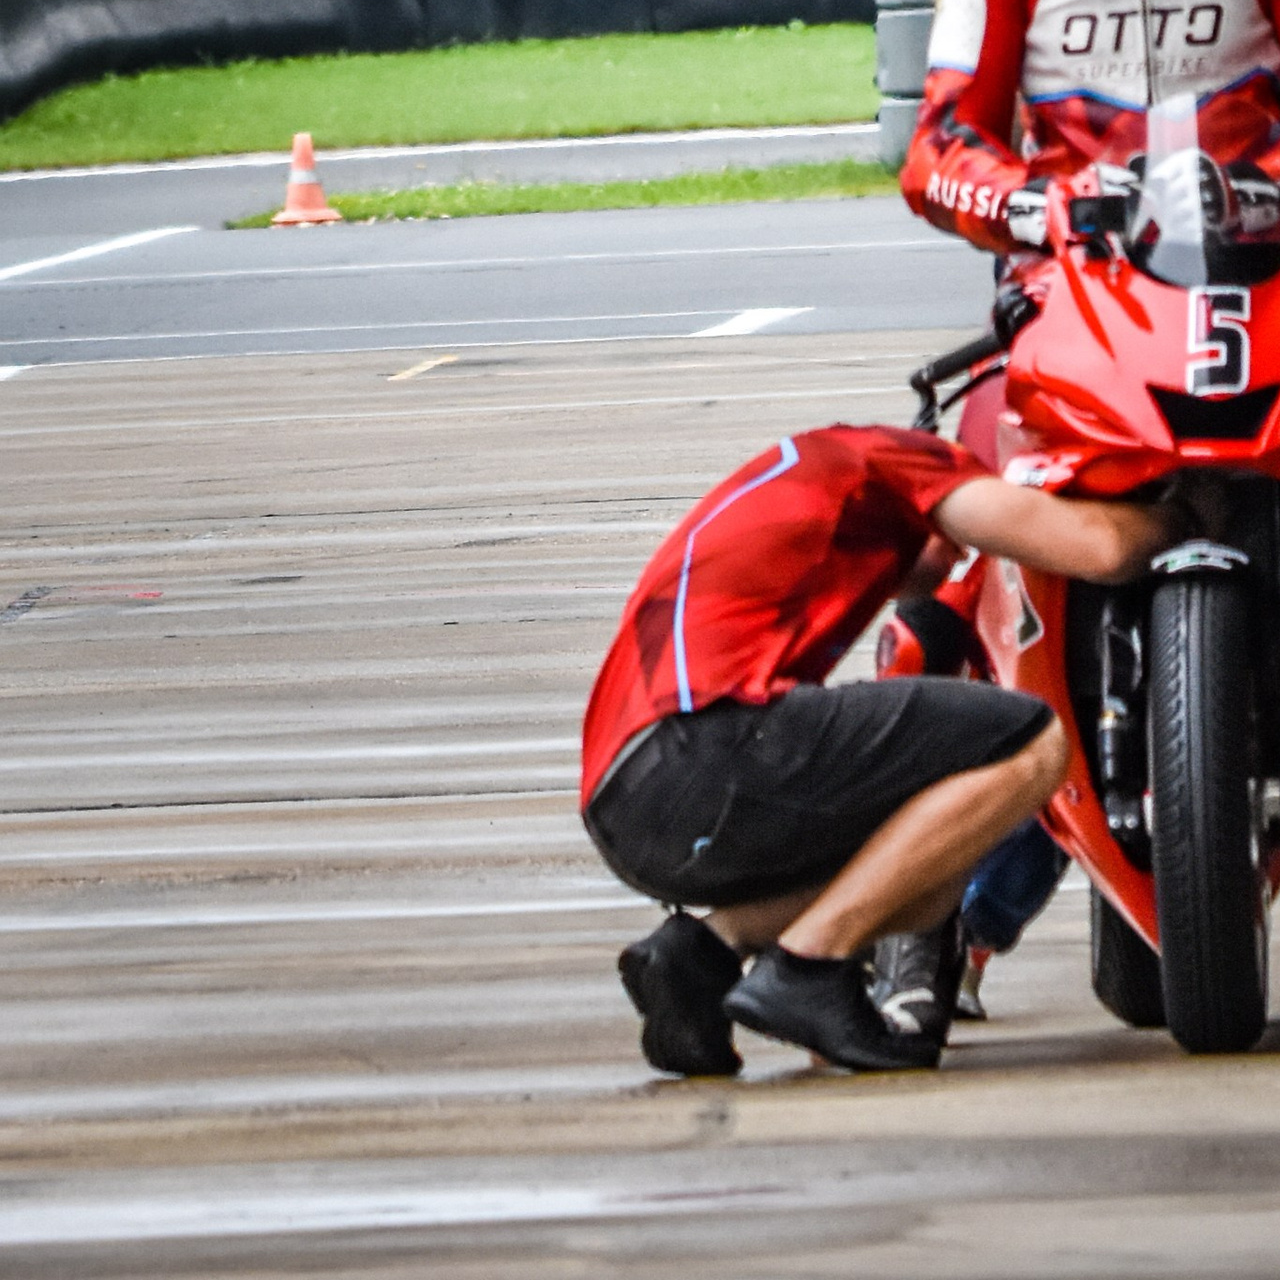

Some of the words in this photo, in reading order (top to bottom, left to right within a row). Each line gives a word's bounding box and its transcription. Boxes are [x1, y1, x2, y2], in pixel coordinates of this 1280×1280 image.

[1062, 4, 1223, 55] OTTO
[926, 171, 1008, 220] RUSSI
[1186, 285, 1250, 397] 5
